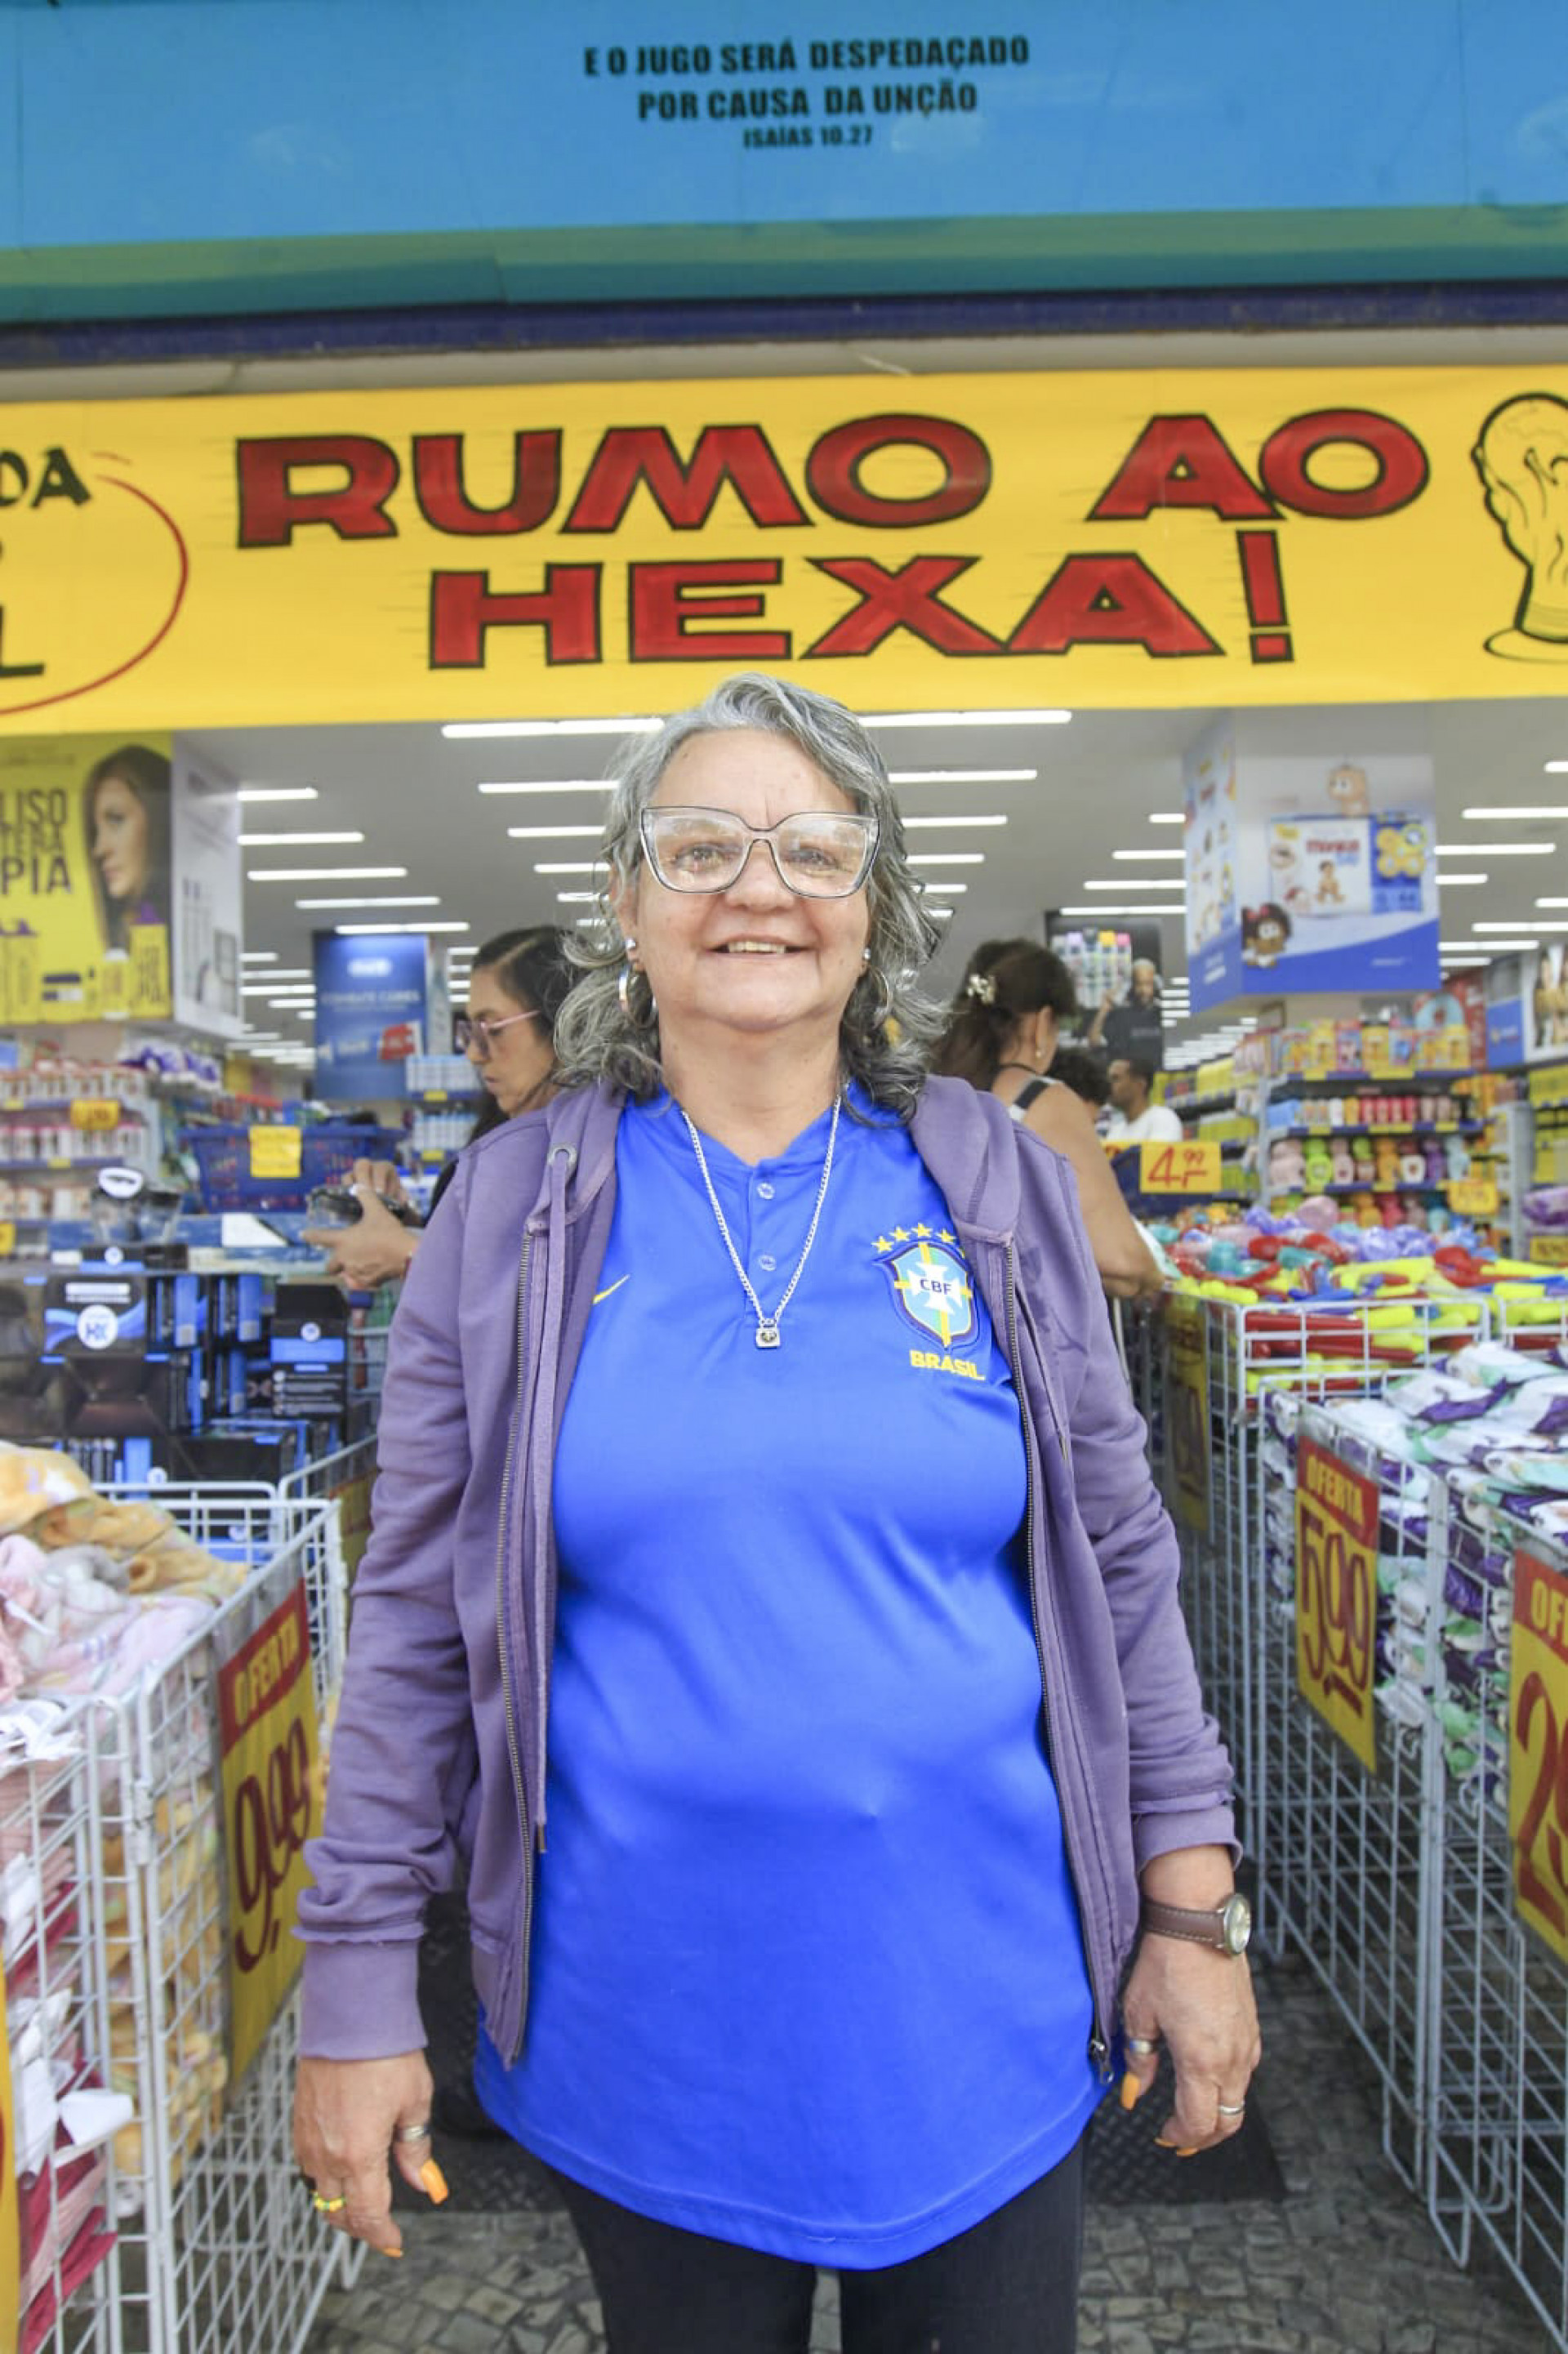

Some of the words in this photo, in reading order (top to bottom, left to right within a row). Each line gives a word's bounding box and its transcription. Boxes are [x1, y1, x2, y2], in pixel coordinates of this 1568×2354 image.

[584, 47, 599, 75] E
[608, 46, 626, 74] O
[636, 44, 710, 74] JUGO
[720, 38, 795, 73] SERÁ
[808, 35, 1030, 71] DESPEDAÇADO
[638, 91, 697, 121] POR
[708, 87, 809, 119] CAUSA
[824, 86, 866, 114] DA
[873, 79, 978, 118] UNÇÃO
[744, 125, 813, 149] ISAÍAS
[821, 125, 872, 146] 10.27
[235, 412, 992, 550] RUMO
[1085, 408, 1431, 521] AO
[428, 528, 1295, 671] HEXA!
[920, 1278, 952, 1295] CBF
[909, 1349, 986, 1381] BRASIL
[1307, 1452, 1365, 1529] OFERTA
[1530, 1576, 1568, 1640] OF
[234, 1611, 301, 1725] OFERTA
